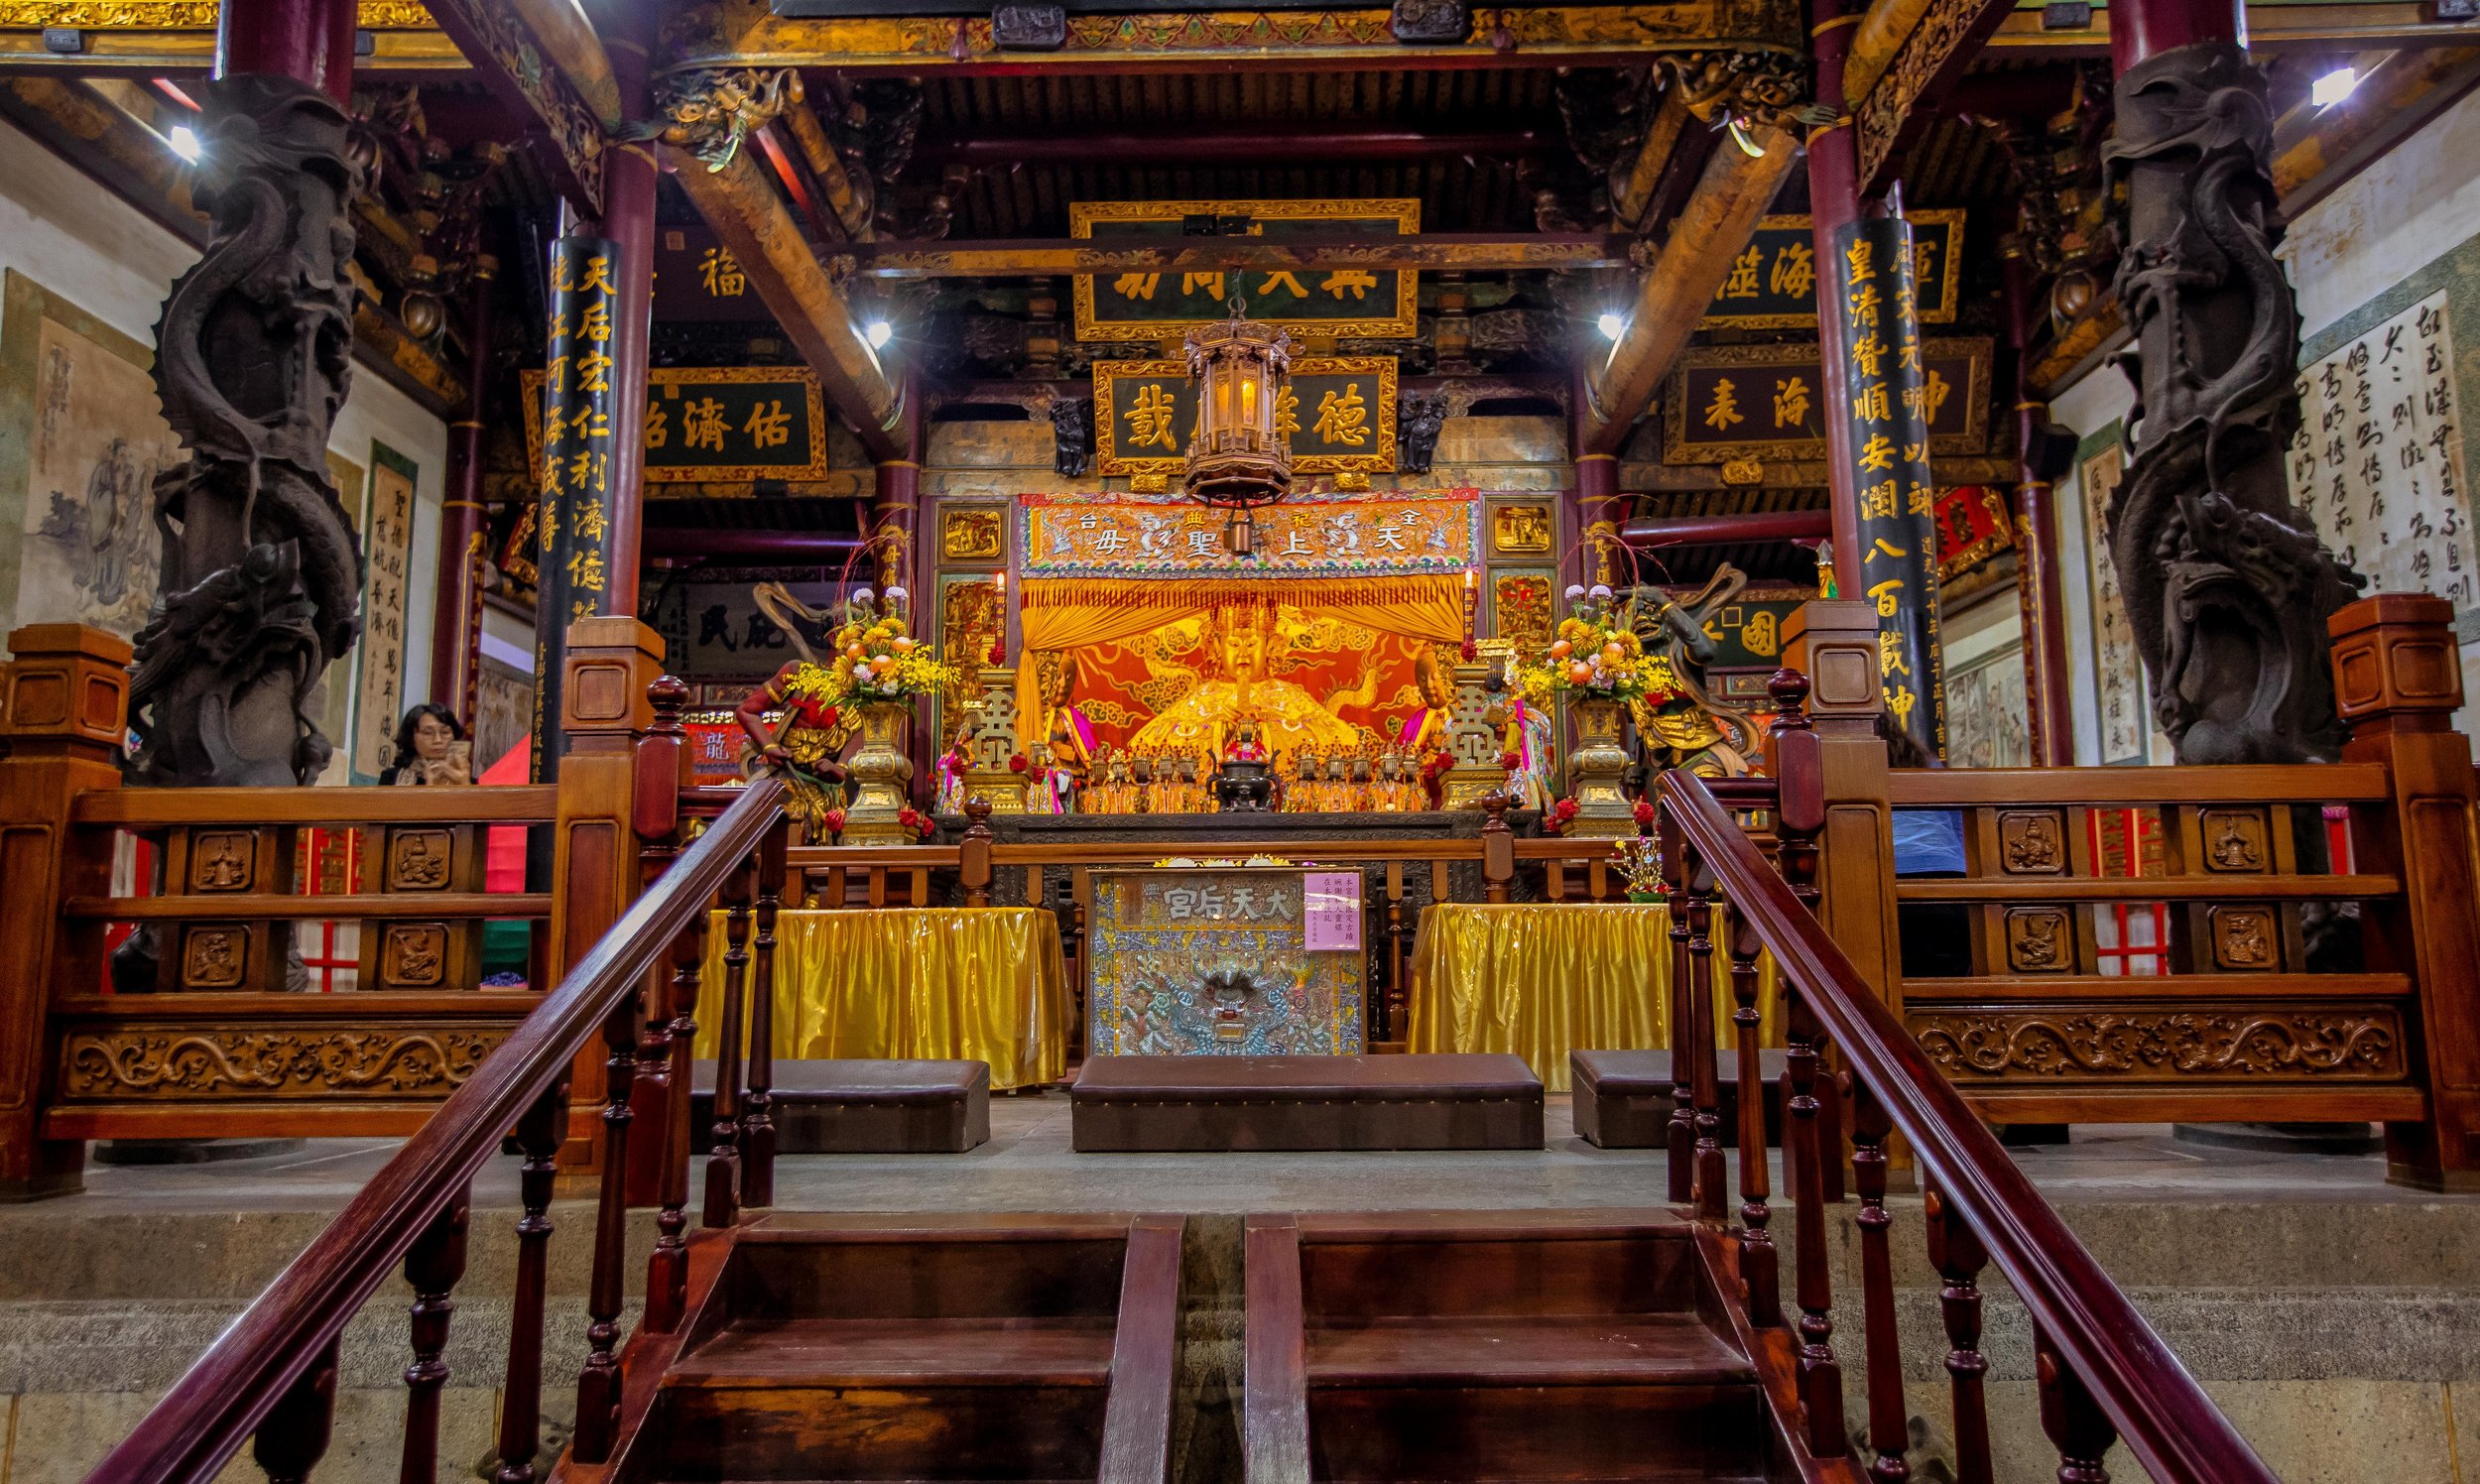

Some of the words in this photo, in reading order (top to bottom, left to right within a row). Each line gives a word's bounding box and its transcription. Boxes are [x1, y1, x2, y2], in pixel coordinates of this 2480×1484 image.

[697, 246, 745, 297] 福
[1164, 885, 1297, 922] 大天后宮
